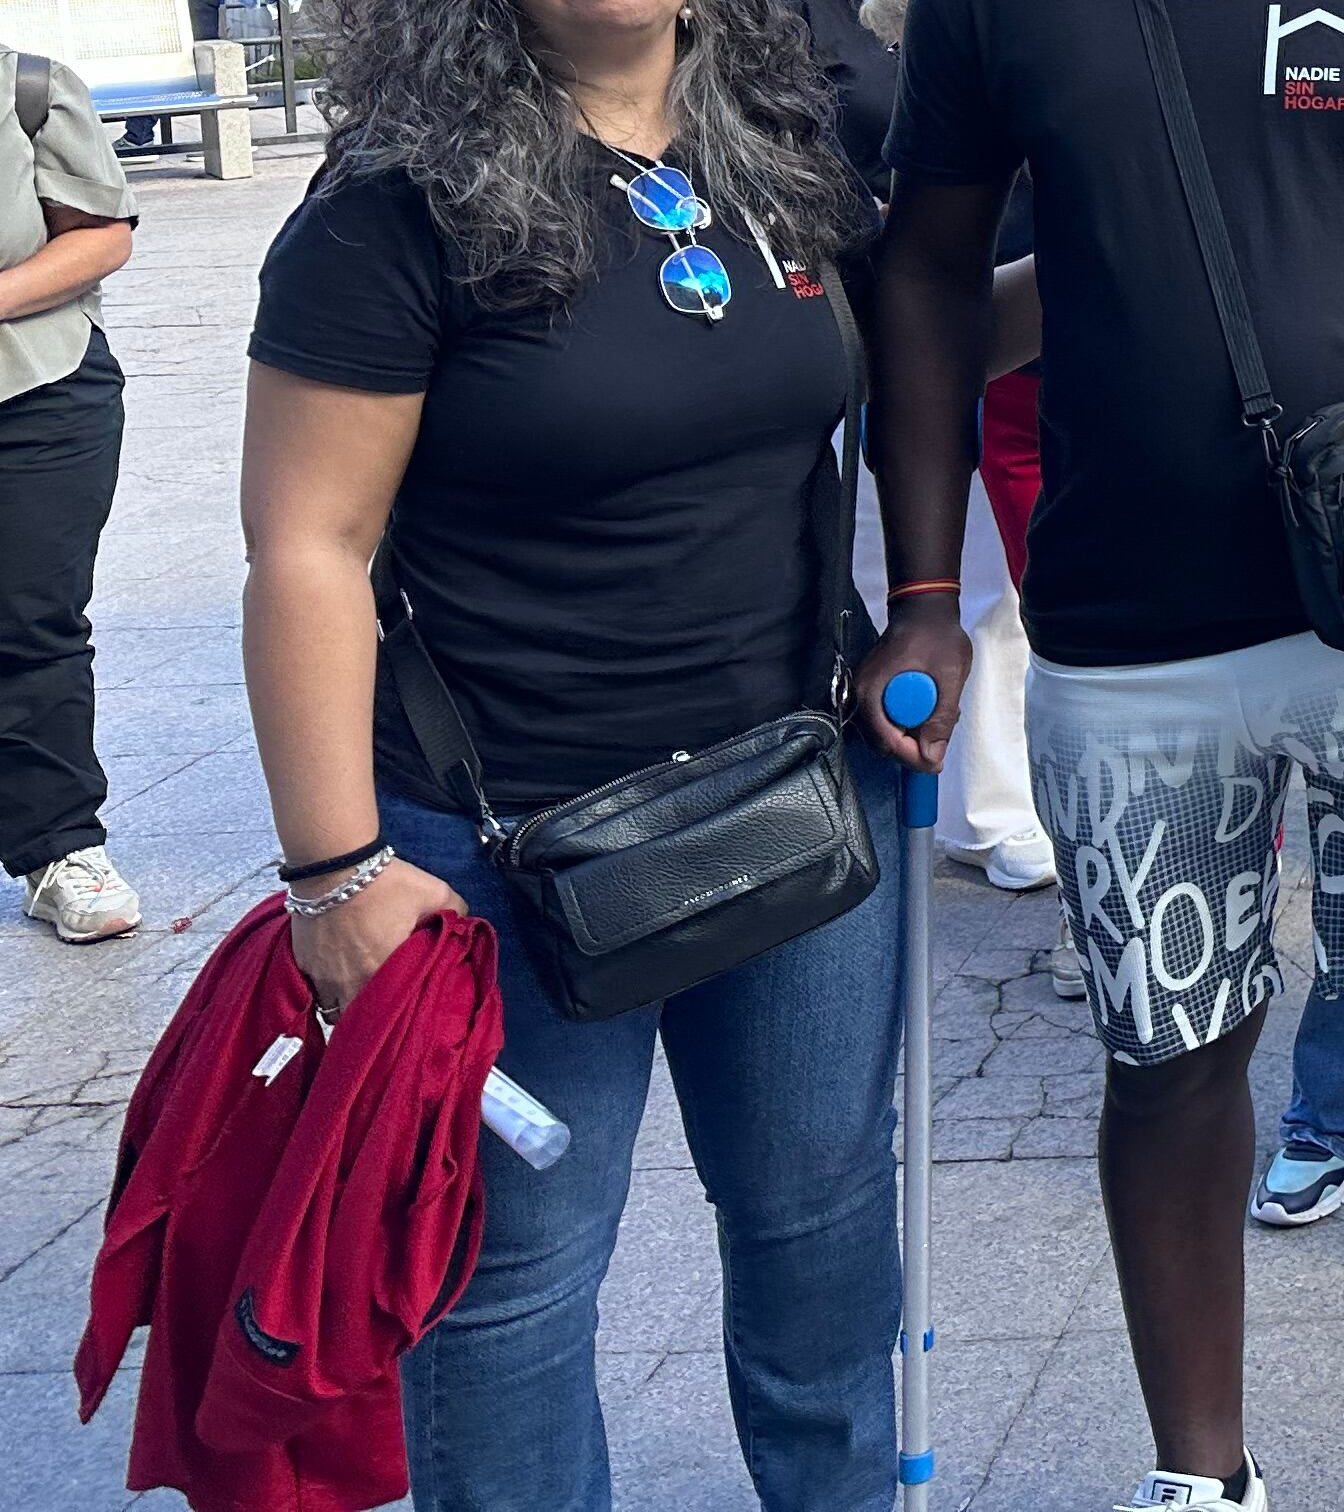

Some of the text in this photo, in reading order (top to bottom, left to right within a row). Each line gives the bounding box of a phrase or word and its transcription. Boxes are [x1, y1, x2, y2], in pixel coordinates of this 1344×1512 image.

[1285, 66, 1341, 82] NADIE
[1284, 81, 1314, 95] SIN
[782, 260, 807, 273] NAD
[793, 282, 824, 299] HOG
